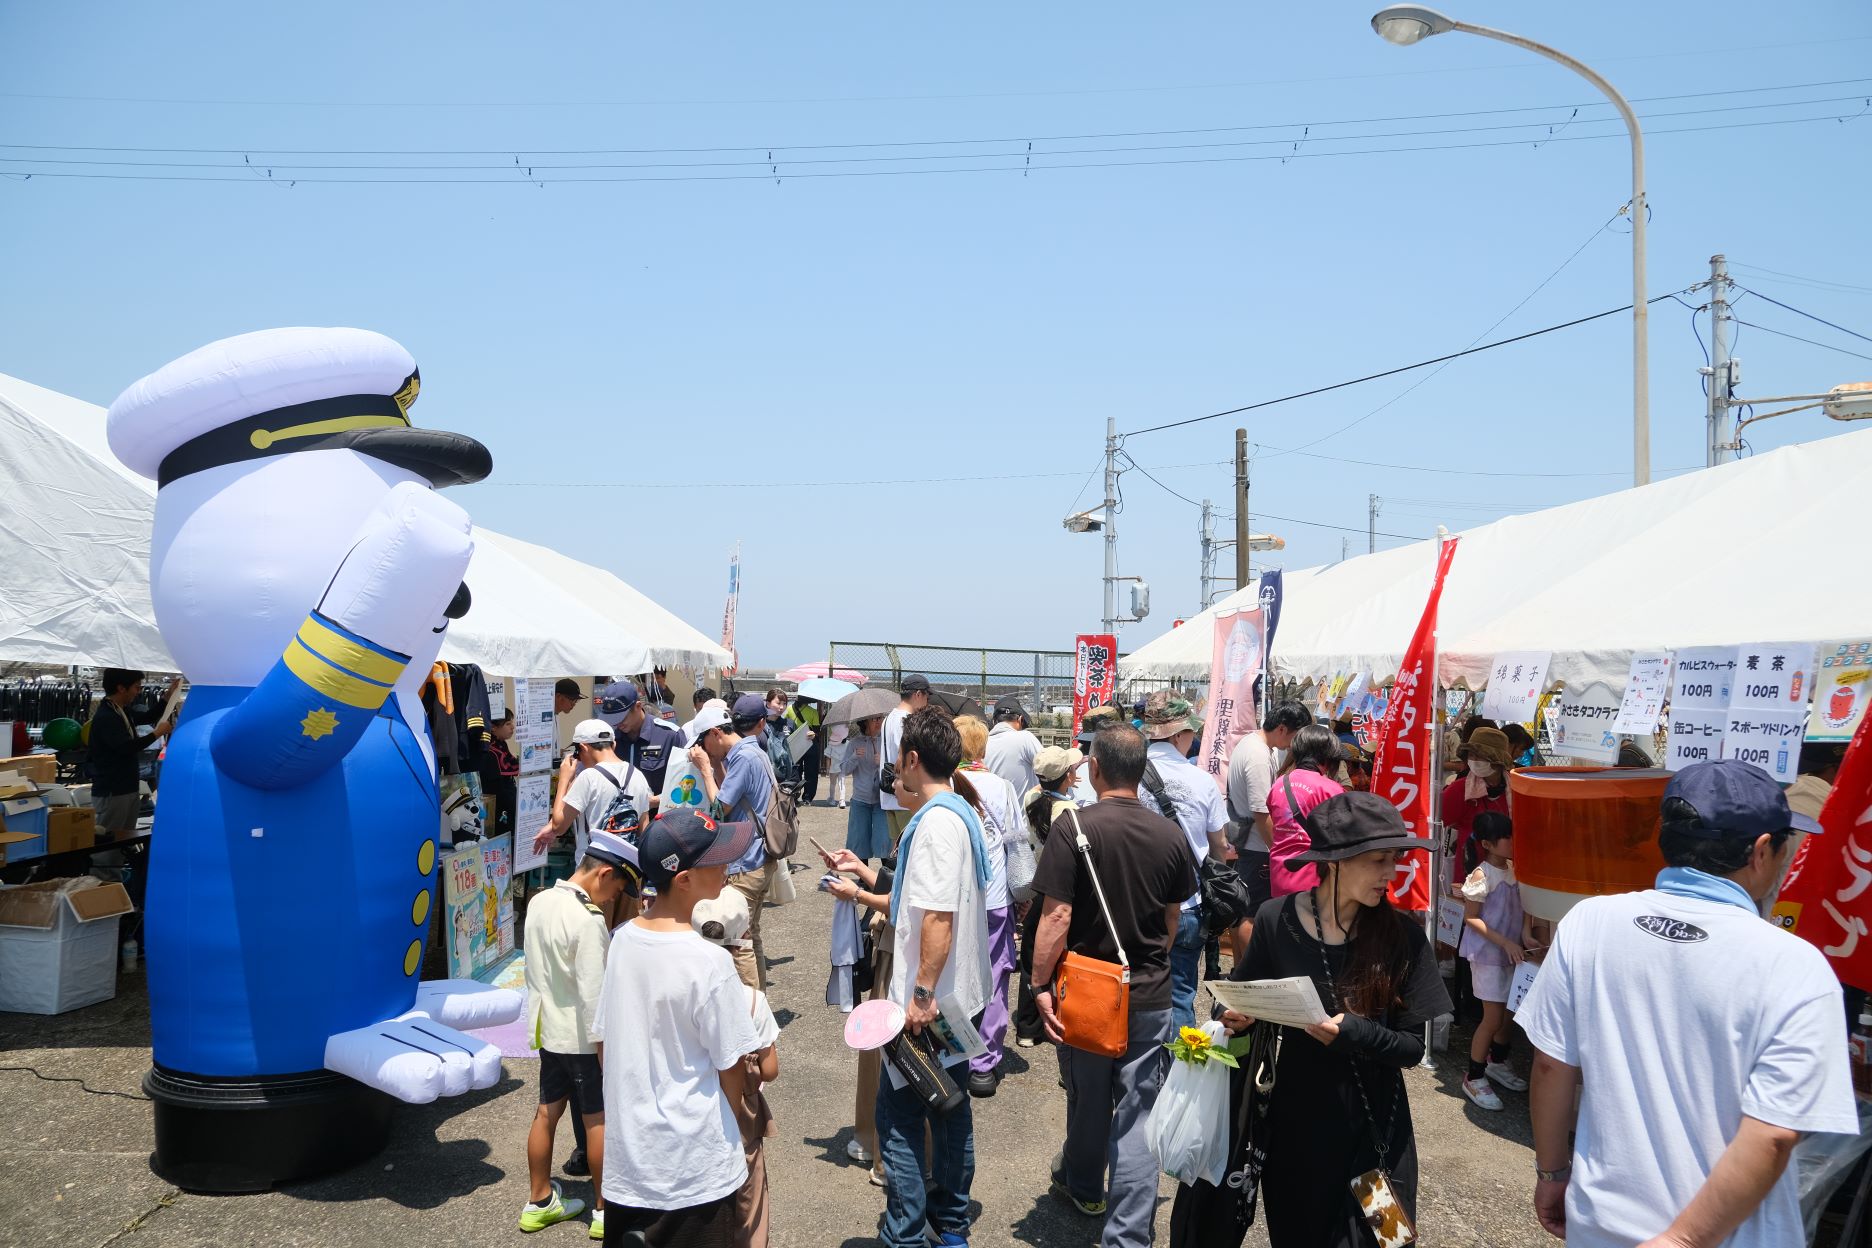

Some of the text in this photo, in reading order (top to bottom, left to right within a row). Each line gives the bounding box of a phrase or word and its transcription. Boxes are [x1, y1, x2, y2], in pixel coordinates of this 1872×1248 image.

[1747, 655, 1785, 671] 麦茶
[1496, 664, 1539, 682] 綿菓子
[1681, 684, 1712, 697] 100円
[1745, 685, 1779, 698] 100円
[1674, 721, 1722, 737] 缶コーヒー
[1730, 721, 1801, 737] スポーツドリンク
[1677, 746, 1708, 760] 100円
[1734, 748, 1770, 764] 100円
